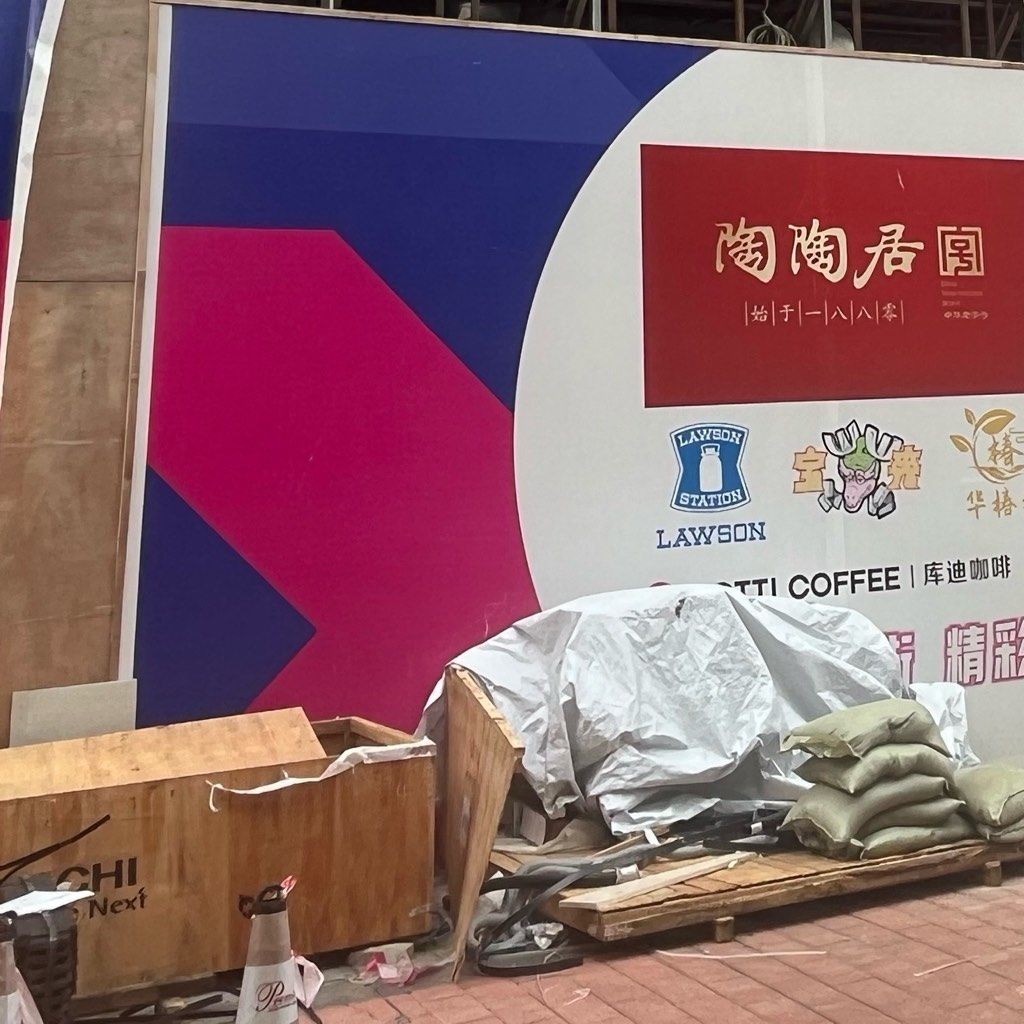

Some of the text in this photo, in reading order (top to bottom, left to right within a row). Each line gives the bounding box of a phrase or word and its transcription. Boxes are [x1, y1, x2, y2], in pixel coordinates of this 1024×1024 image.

[715, 216, 925, 290] 陶陶居
[678, 429, 742, 447] LAWSON
[679, 489, 743, 508] STATION
[656, 521, 767, 549] LAWSON
[788, 566, 900, 600] COFFEE
[924, 554, 1012, 586] 库迪咖啡
[89, 886, 149, 919] Next
